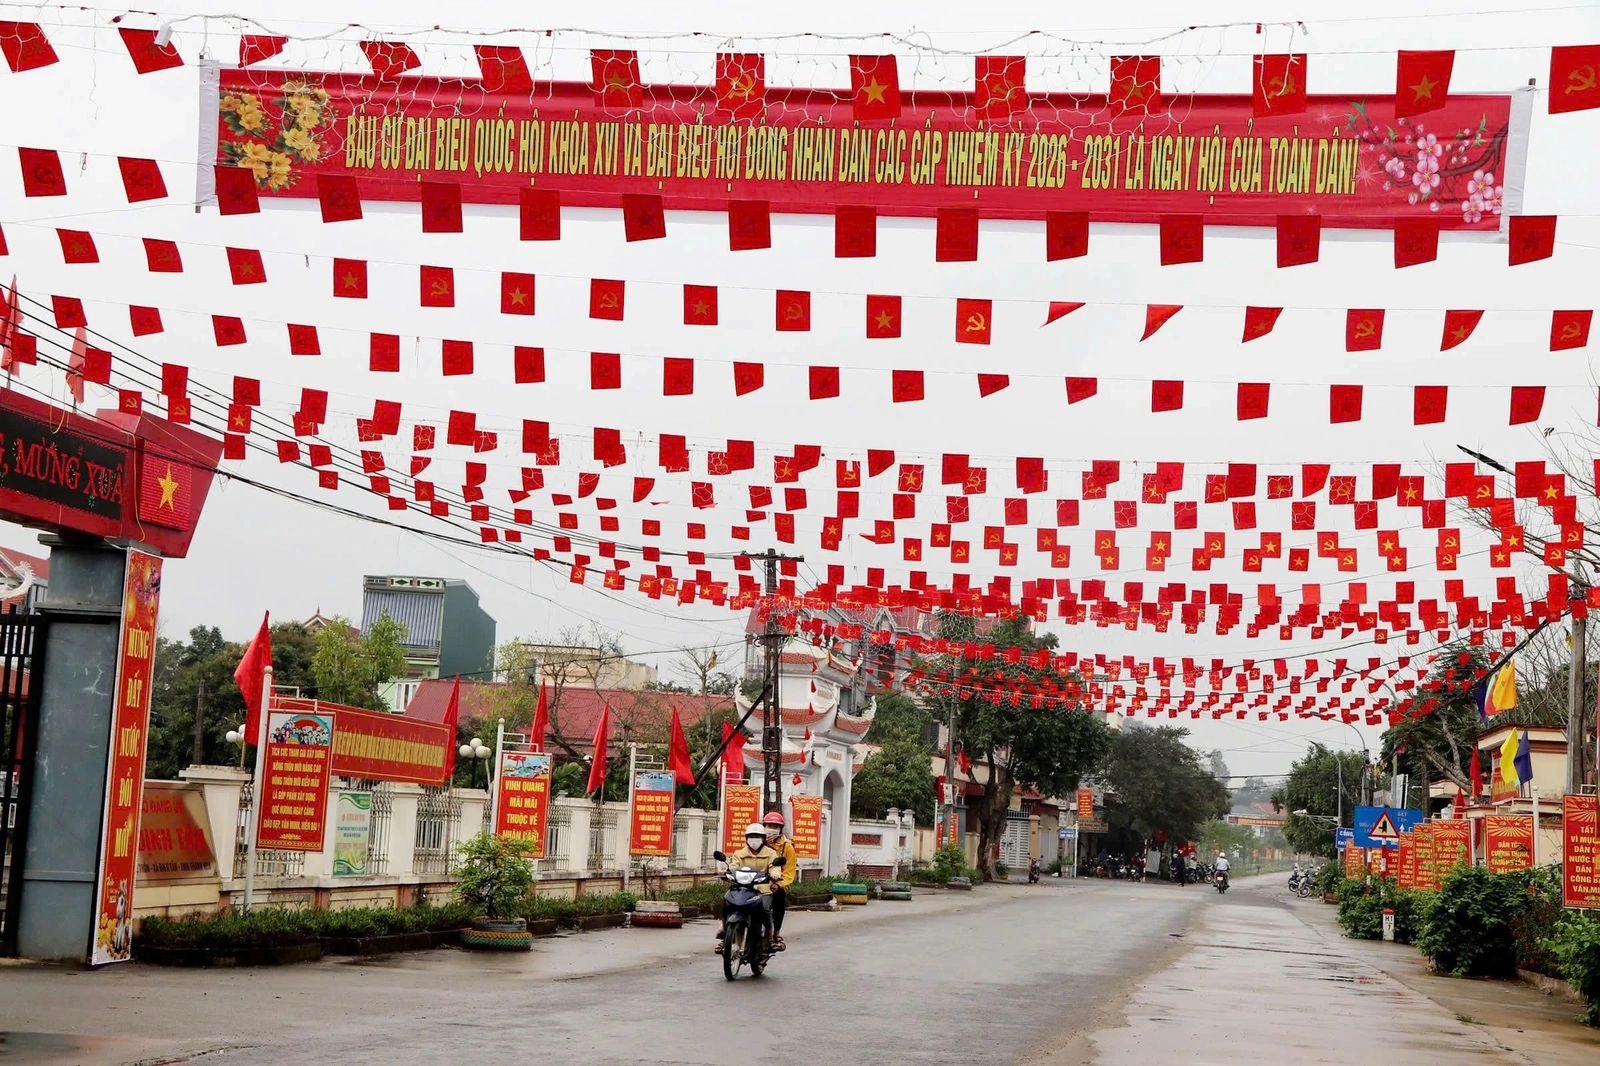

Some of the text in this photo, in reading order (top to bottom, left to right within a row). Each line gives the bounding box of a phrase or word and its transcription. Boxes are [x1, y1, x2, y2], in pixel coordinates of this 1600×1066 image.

[345, 96, 1359, 205] BẦU CỬ ĐẠI BIỂU QUỐC HỘI KHÓA XVI VÀ ĐẠI BIỂU HỘI ĐỒNG NHÂN DÂN CÁC CẤP NHIỆM KỲ 2026 - 2031 LÀ NGÀY HỘI CỦA TOÀN DÂN!
[14, 437, 81, 490] MỪNG
[127, 622, 149, 659] MỪNG
[126, 669, 143, 708] ĐẤT
[119, 721, 140, 757] NƯỚC
[118, 766, 133, 807] ĐỔI
[505, 780, 545, 792] VINH QUANG
[509, 796, 537, 809] MÃI MÃI
[506, 812, 538, 826] THUỘC VỀ
[1580, 825, 1594, 834] TẤT
[113, 821, 130, 857] MỚI
[1570, 834, 1578, 843] VÌ
[1574, 845, 1590, 853] DÂN
[1569, 854, 1591, 864] NƯỚC
[1575, 865, 1592, 873] DÂN
[1570, 874, 1592, 883] CÔNG
[1572, 885, 1588, 893] VĂN
